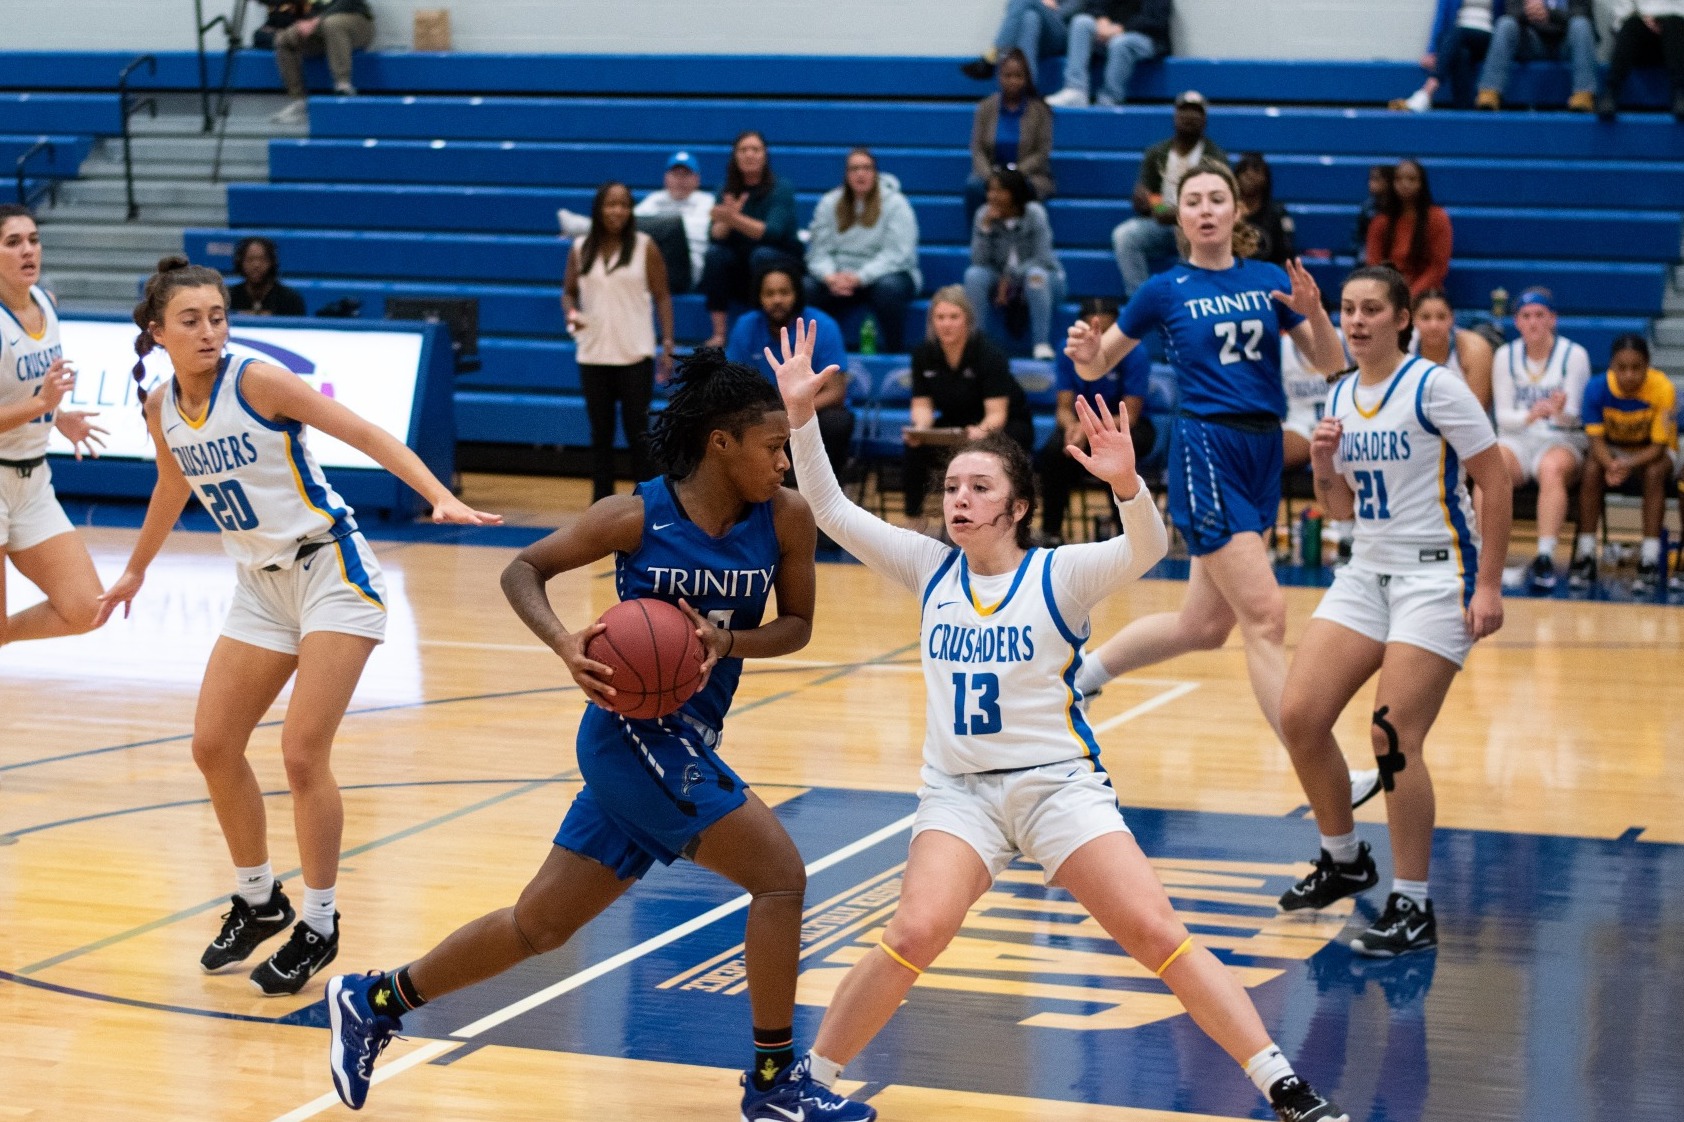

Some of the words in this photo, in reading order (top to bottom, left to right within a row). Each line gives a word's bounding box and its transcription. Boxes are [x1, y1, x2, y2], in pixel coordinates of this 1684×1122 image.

[1184, 290, 1273, 319] TRINITY
[1214, 319, 1264, 366] 22
[200, 479, 259, 531] 20
[1353, 470, 1391, 519] 21
[647, 564, 775, 597] TRINITY
[928, 623, 1034, 663] CRUSADERS
[952, 672, 1002, 735] 13
